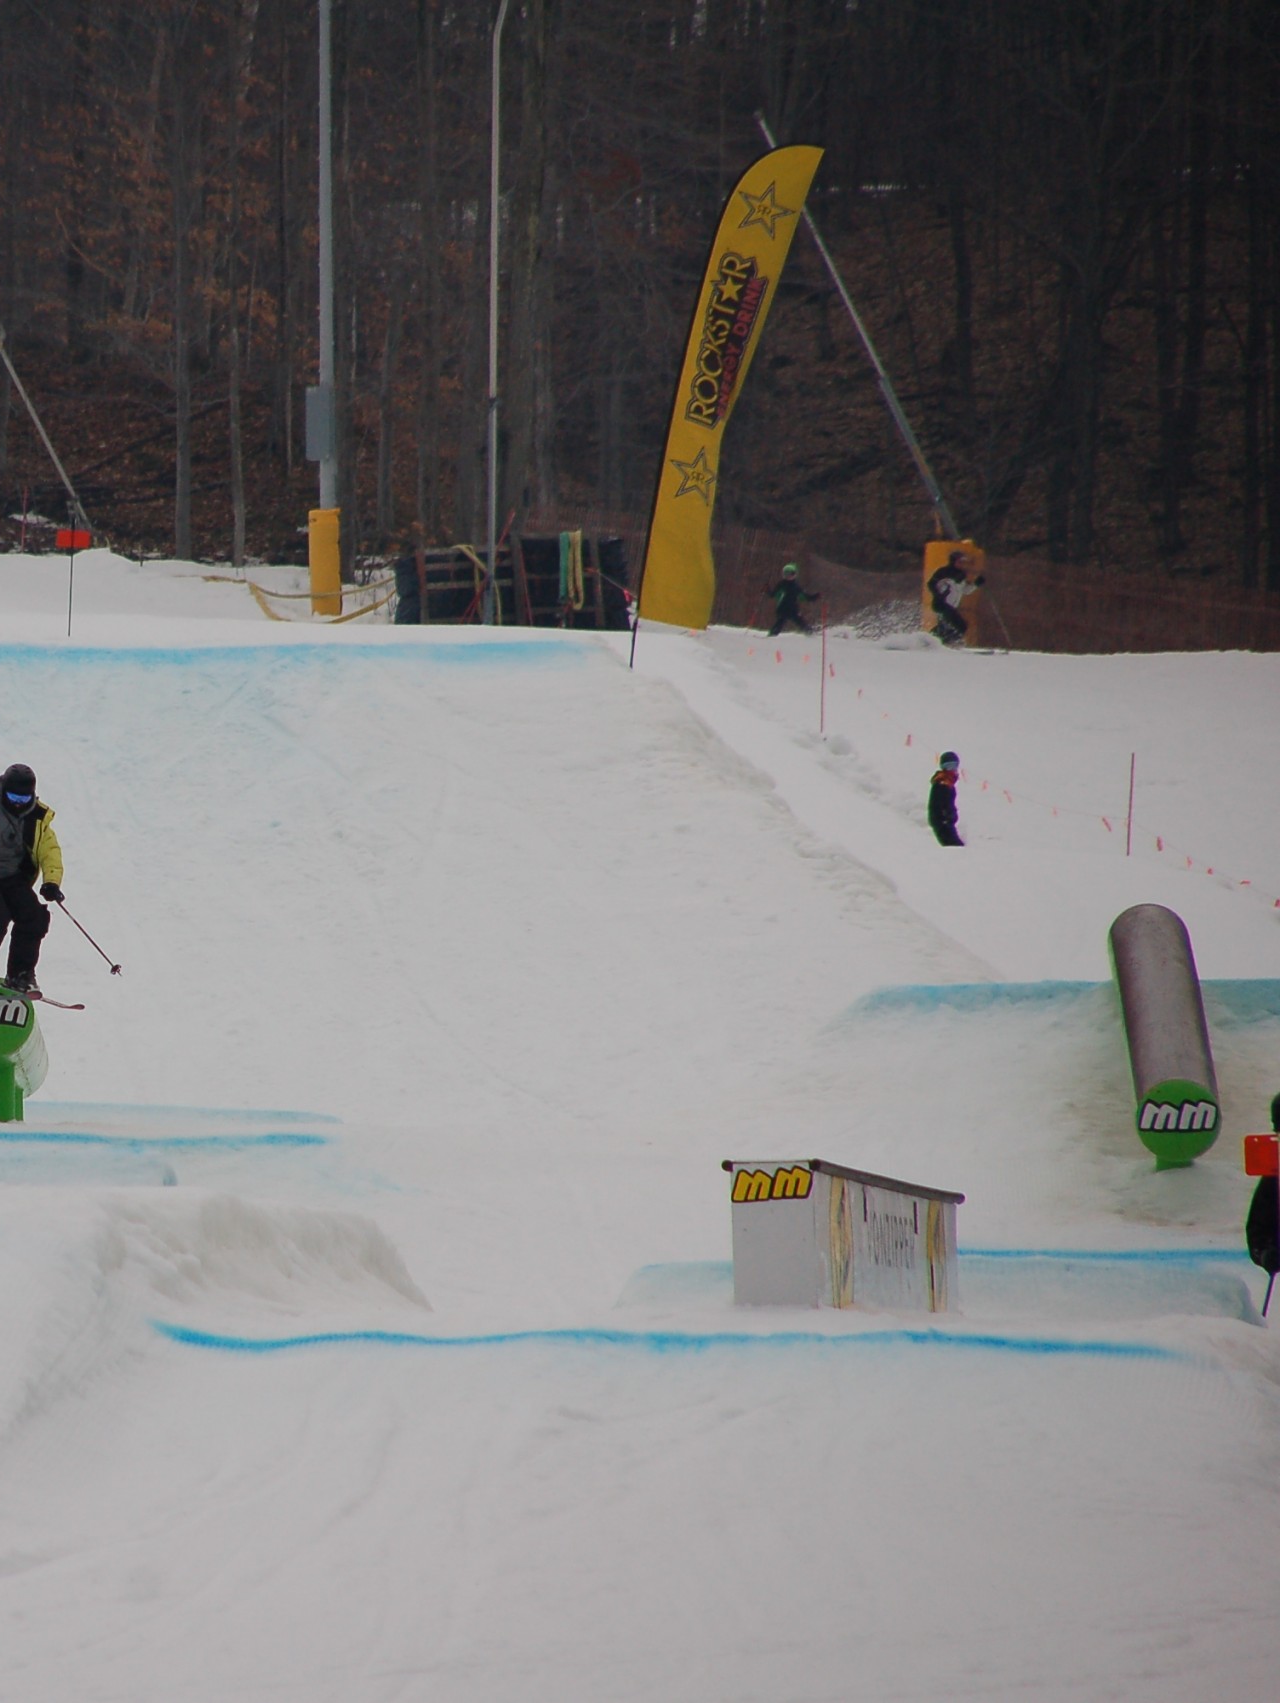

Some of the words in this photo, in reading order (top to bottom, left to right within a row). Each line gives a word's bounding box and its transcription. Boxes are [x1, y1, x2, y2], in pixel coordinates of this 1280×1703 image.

[733, 276, 763, 338] DRINK
[1139, 1099, 1219, 1132] mm
[732, 1165, 814, 1203] mm
